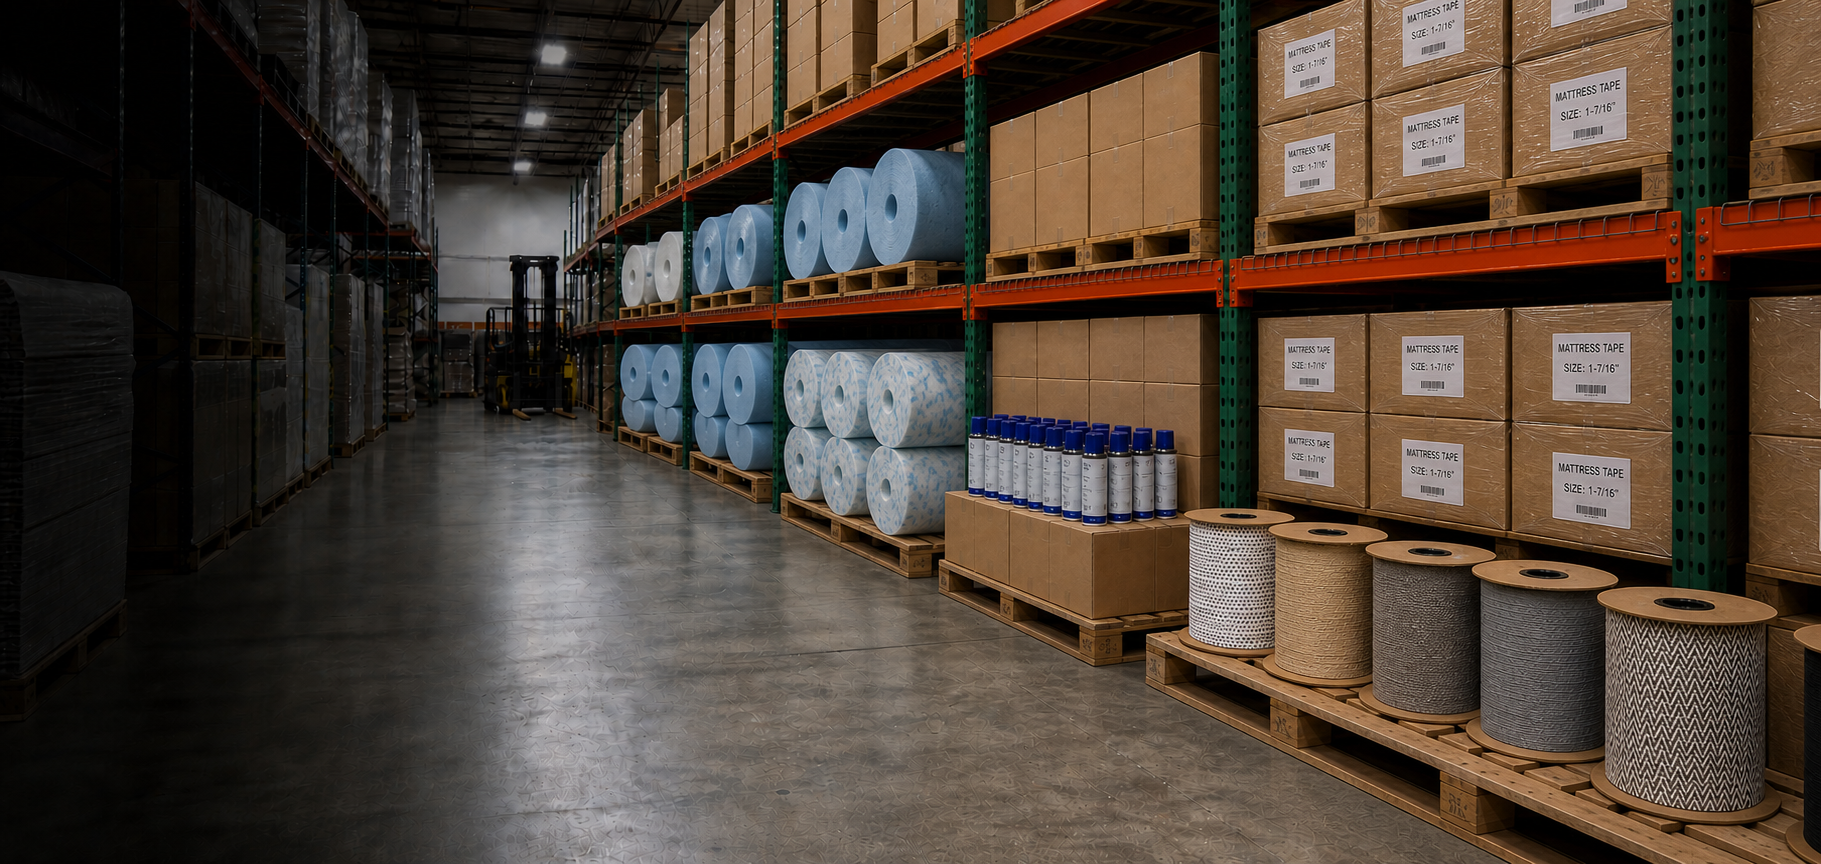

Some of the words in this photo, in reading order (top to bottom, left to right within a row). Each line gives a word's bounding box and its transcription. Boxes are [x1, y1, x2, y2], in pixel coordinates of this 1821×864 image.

[1406, 5, 1440, 25] MATTRESS
[1441, 0, 1460, 13] TAPE
[1411, 28, 1430, 41] SIZE:
[1288, 43, 1316, 59] MATTRESS
[1316, 38, 1332, 50] TAPE
[1291, 62, 1307, 74] SIZE:
[1555, 85, 1597, 103] MATTRESS
[1598, 79, 1621, 94] TAPE
[1560, 108, 1582, 122] SIZE:
[1407, 118, 1441, 134] MATTRESS
[1442, 114, 1460, 127] TAPE
[1287, 145, 1315, 158] MATTRESS
[1316, 142, 1332, 152] TAPE
[1411, 138, 1430, 151] SIZE:
[1291, 163, 1307, 174] SIZE:
[1287, 345, 1315, 354] MATTRESS
[1316, 345, 1331, 354] TAPE
[1406, 344, 1440, 354] MATTRESS
[1441, 344, 1460, 354] TAPE
[1557, 342, 1601, 354] MATTRESS
[1602, 342, 1625, 354] TAPE
[1291, 360, 1308, 370] SIZE:
[1409, 361, 1429, 372] SIZE:
[1562, 362, 1586, 373] SIZE:
[1287, 436, 1315, 448] MATTRESS
[1316, 439, 1331, 449] TAPE
[1290, 451, 1307, 462] SIZE:
[1406, 447, 1440, 460] MATTRESS
[1441, 451, 1459, 463] TAPE
[1410, 465, 1429, 477] SIZE:
[1557, 462, 1600, 477] MATTRESS
[1601, 466, 1625, 479] TAPE
[1562, 482, 1587, 495] SIZE:
